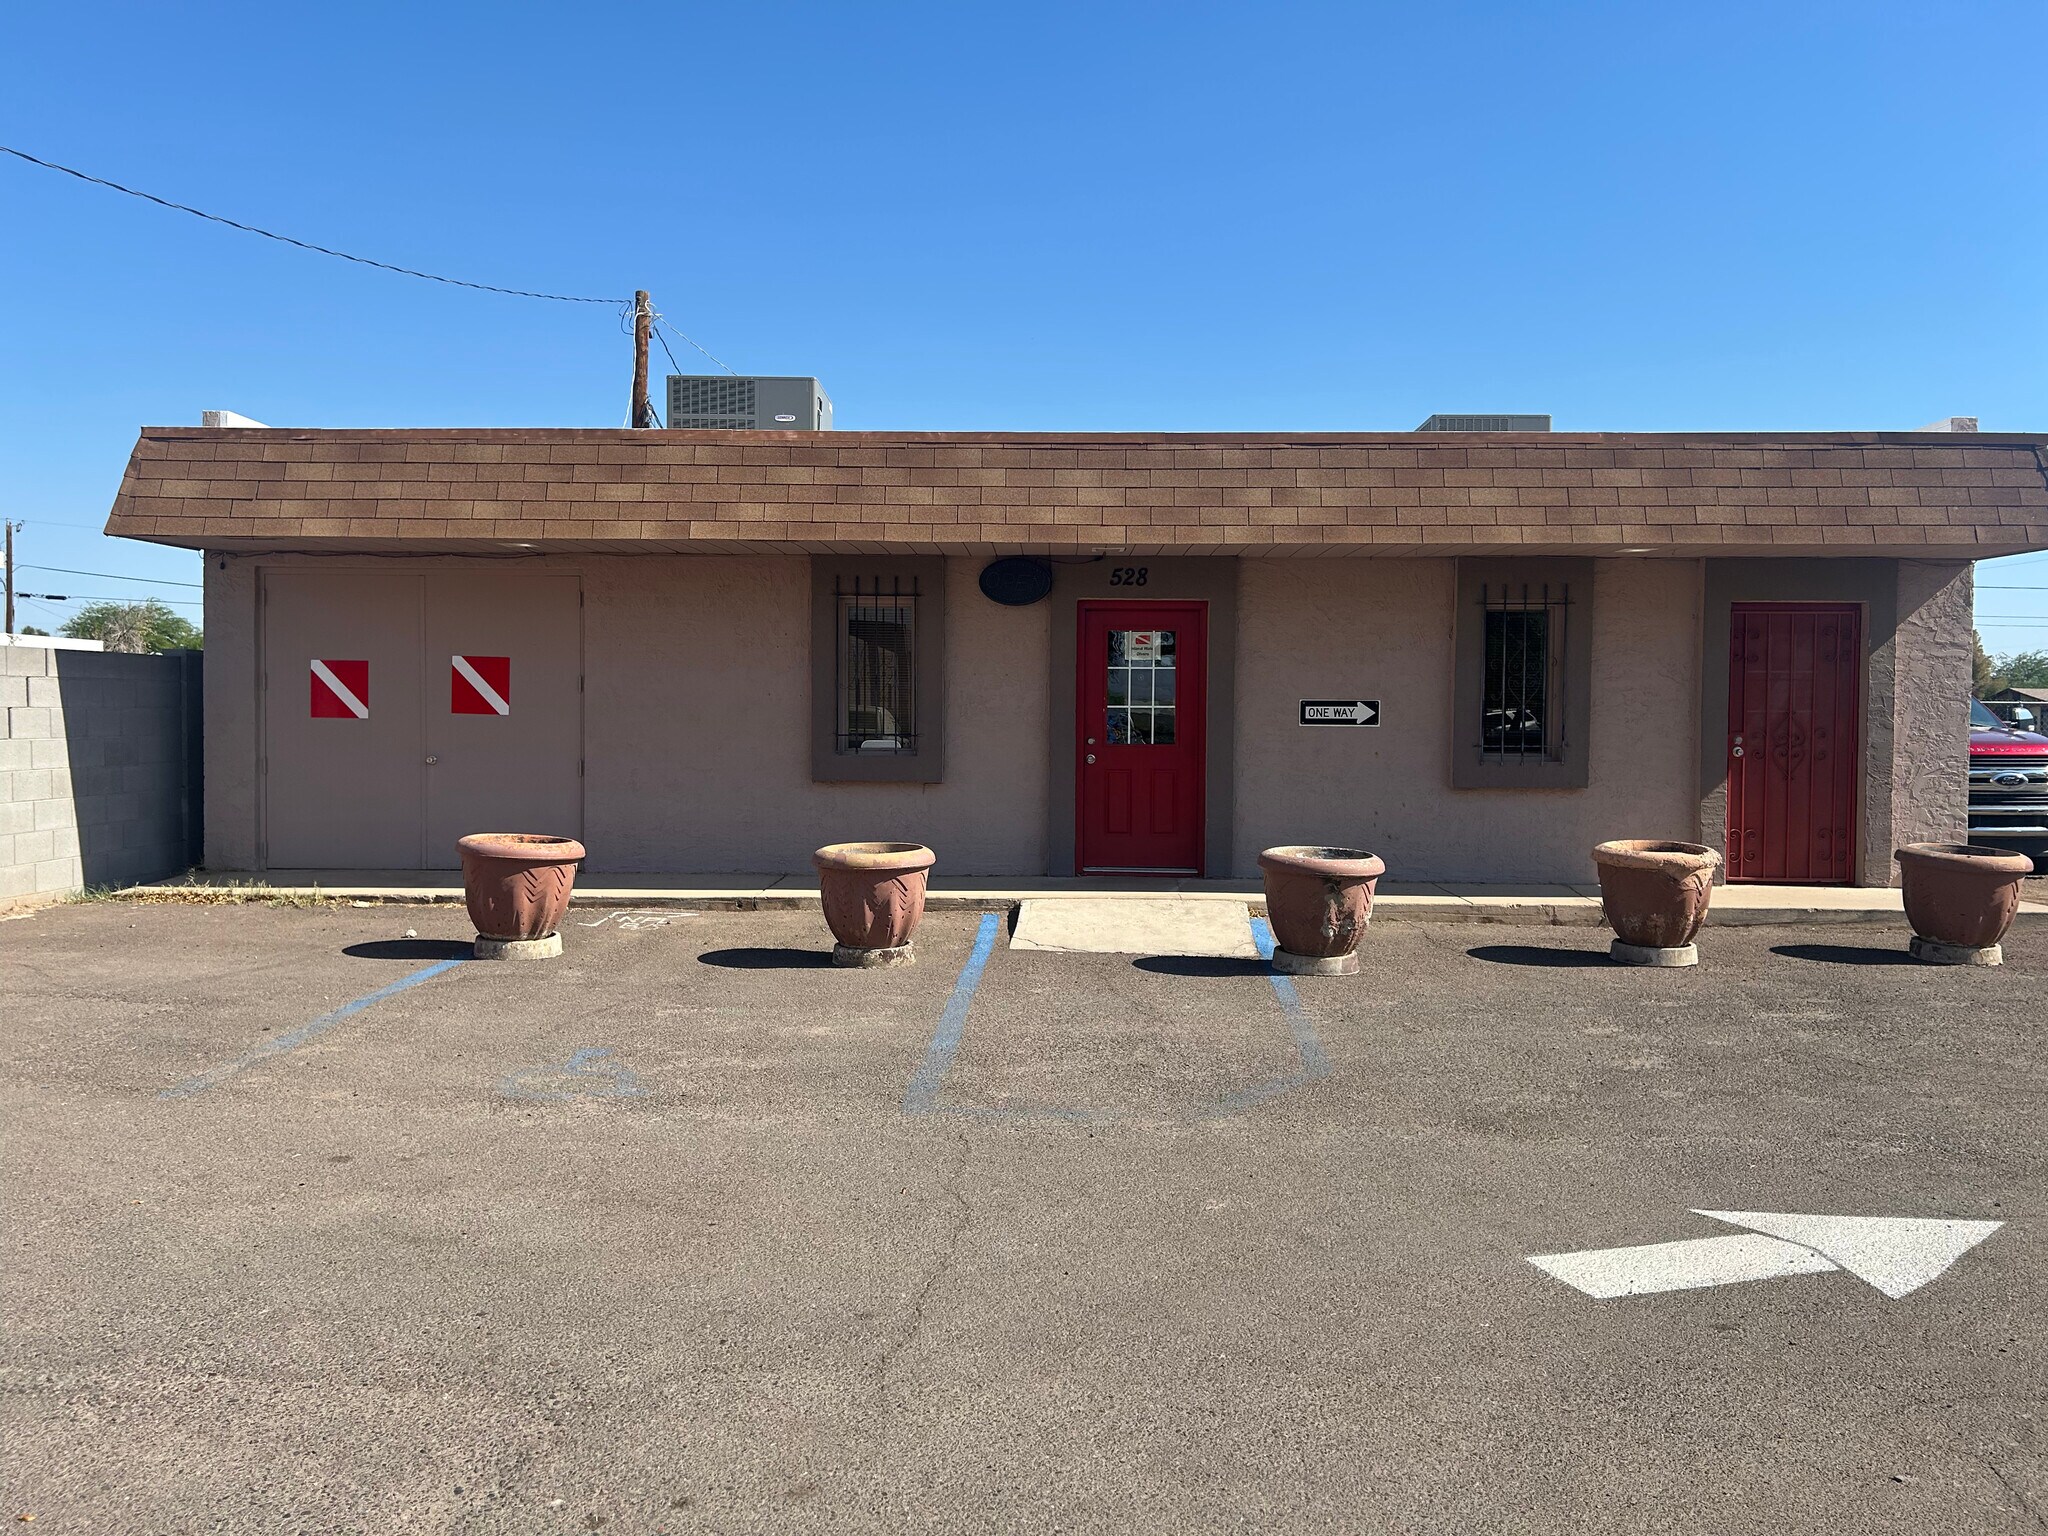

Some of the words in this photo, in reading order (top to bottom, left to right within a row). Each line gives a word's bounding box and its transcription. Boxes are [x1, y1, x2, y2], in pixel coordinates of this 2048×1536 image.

[1109, 567, 1149, 587] 528
[1308, 707, 1330, 718] ONE
[1333, 707, 1356, 718] WAY
